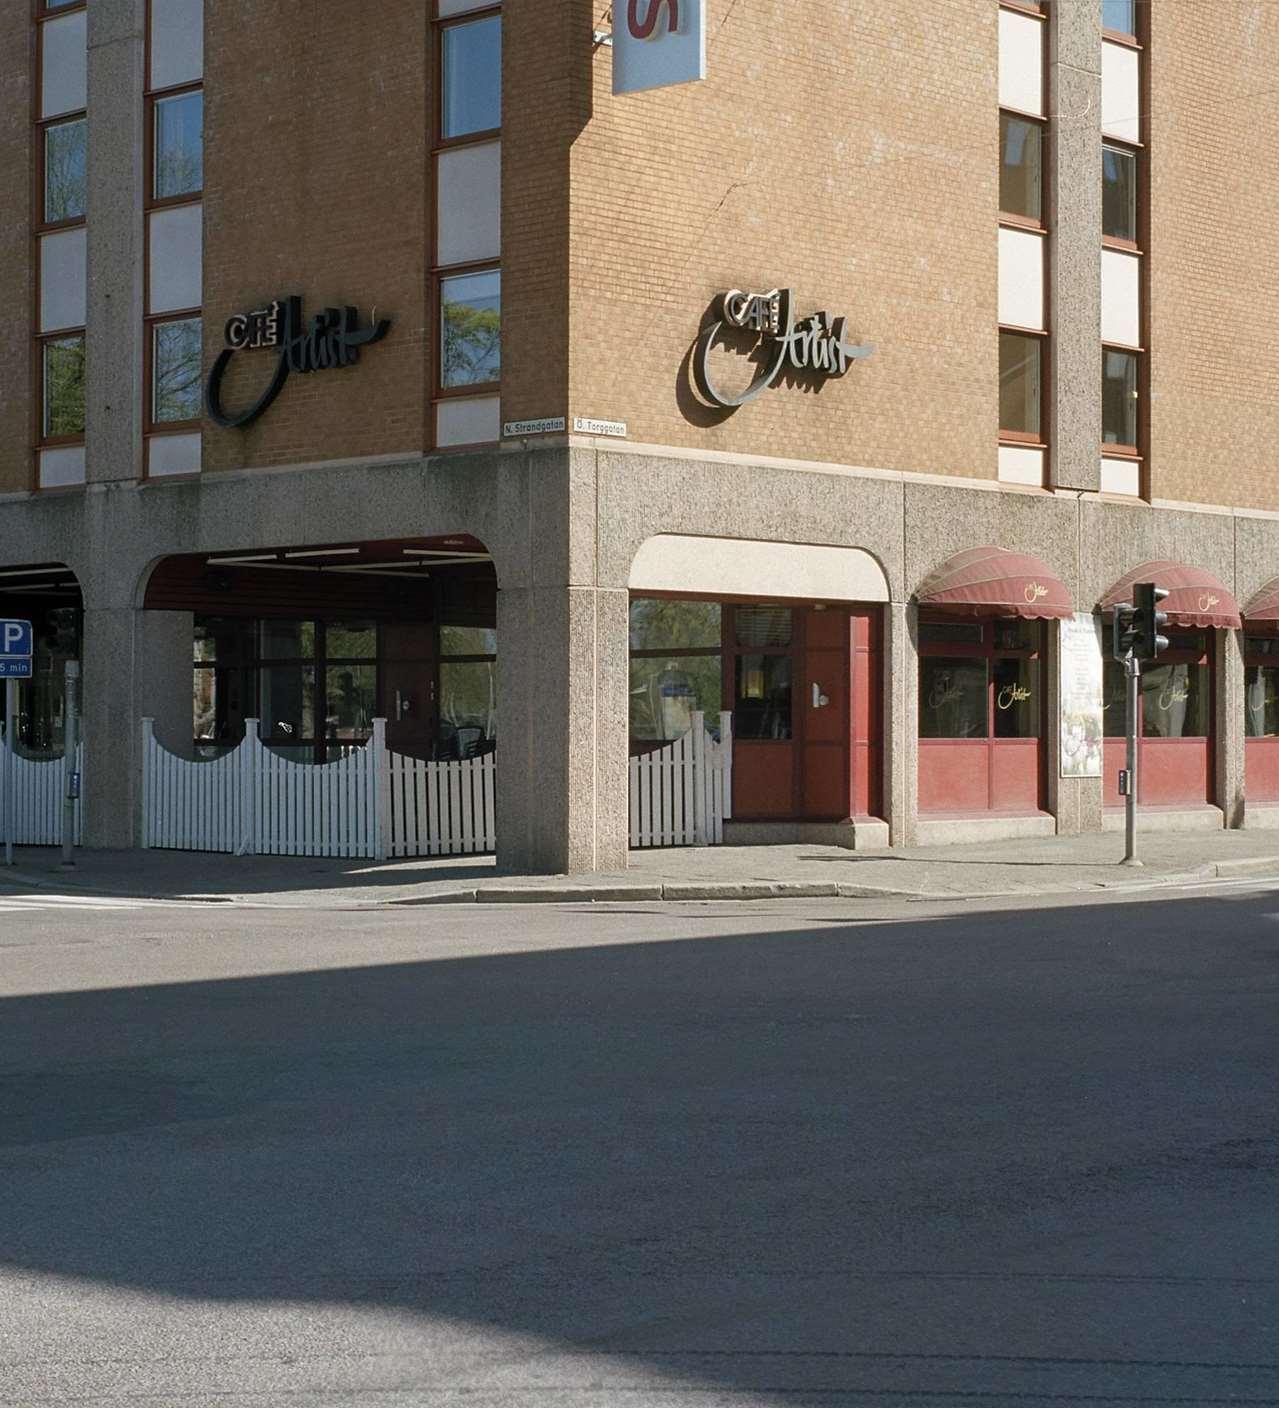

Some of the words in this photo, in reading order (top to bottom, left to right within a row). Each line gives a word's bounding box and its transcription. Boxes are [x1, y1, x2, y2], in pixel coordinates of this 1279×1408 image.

[224, 300, 282, 351] CFÉ
[515, 420, 564, 434] Strandgatan
[587, 421, 625, 435] Torggatan
[4, 623, 23, 653] P
[9, 663, 28, 672] min
